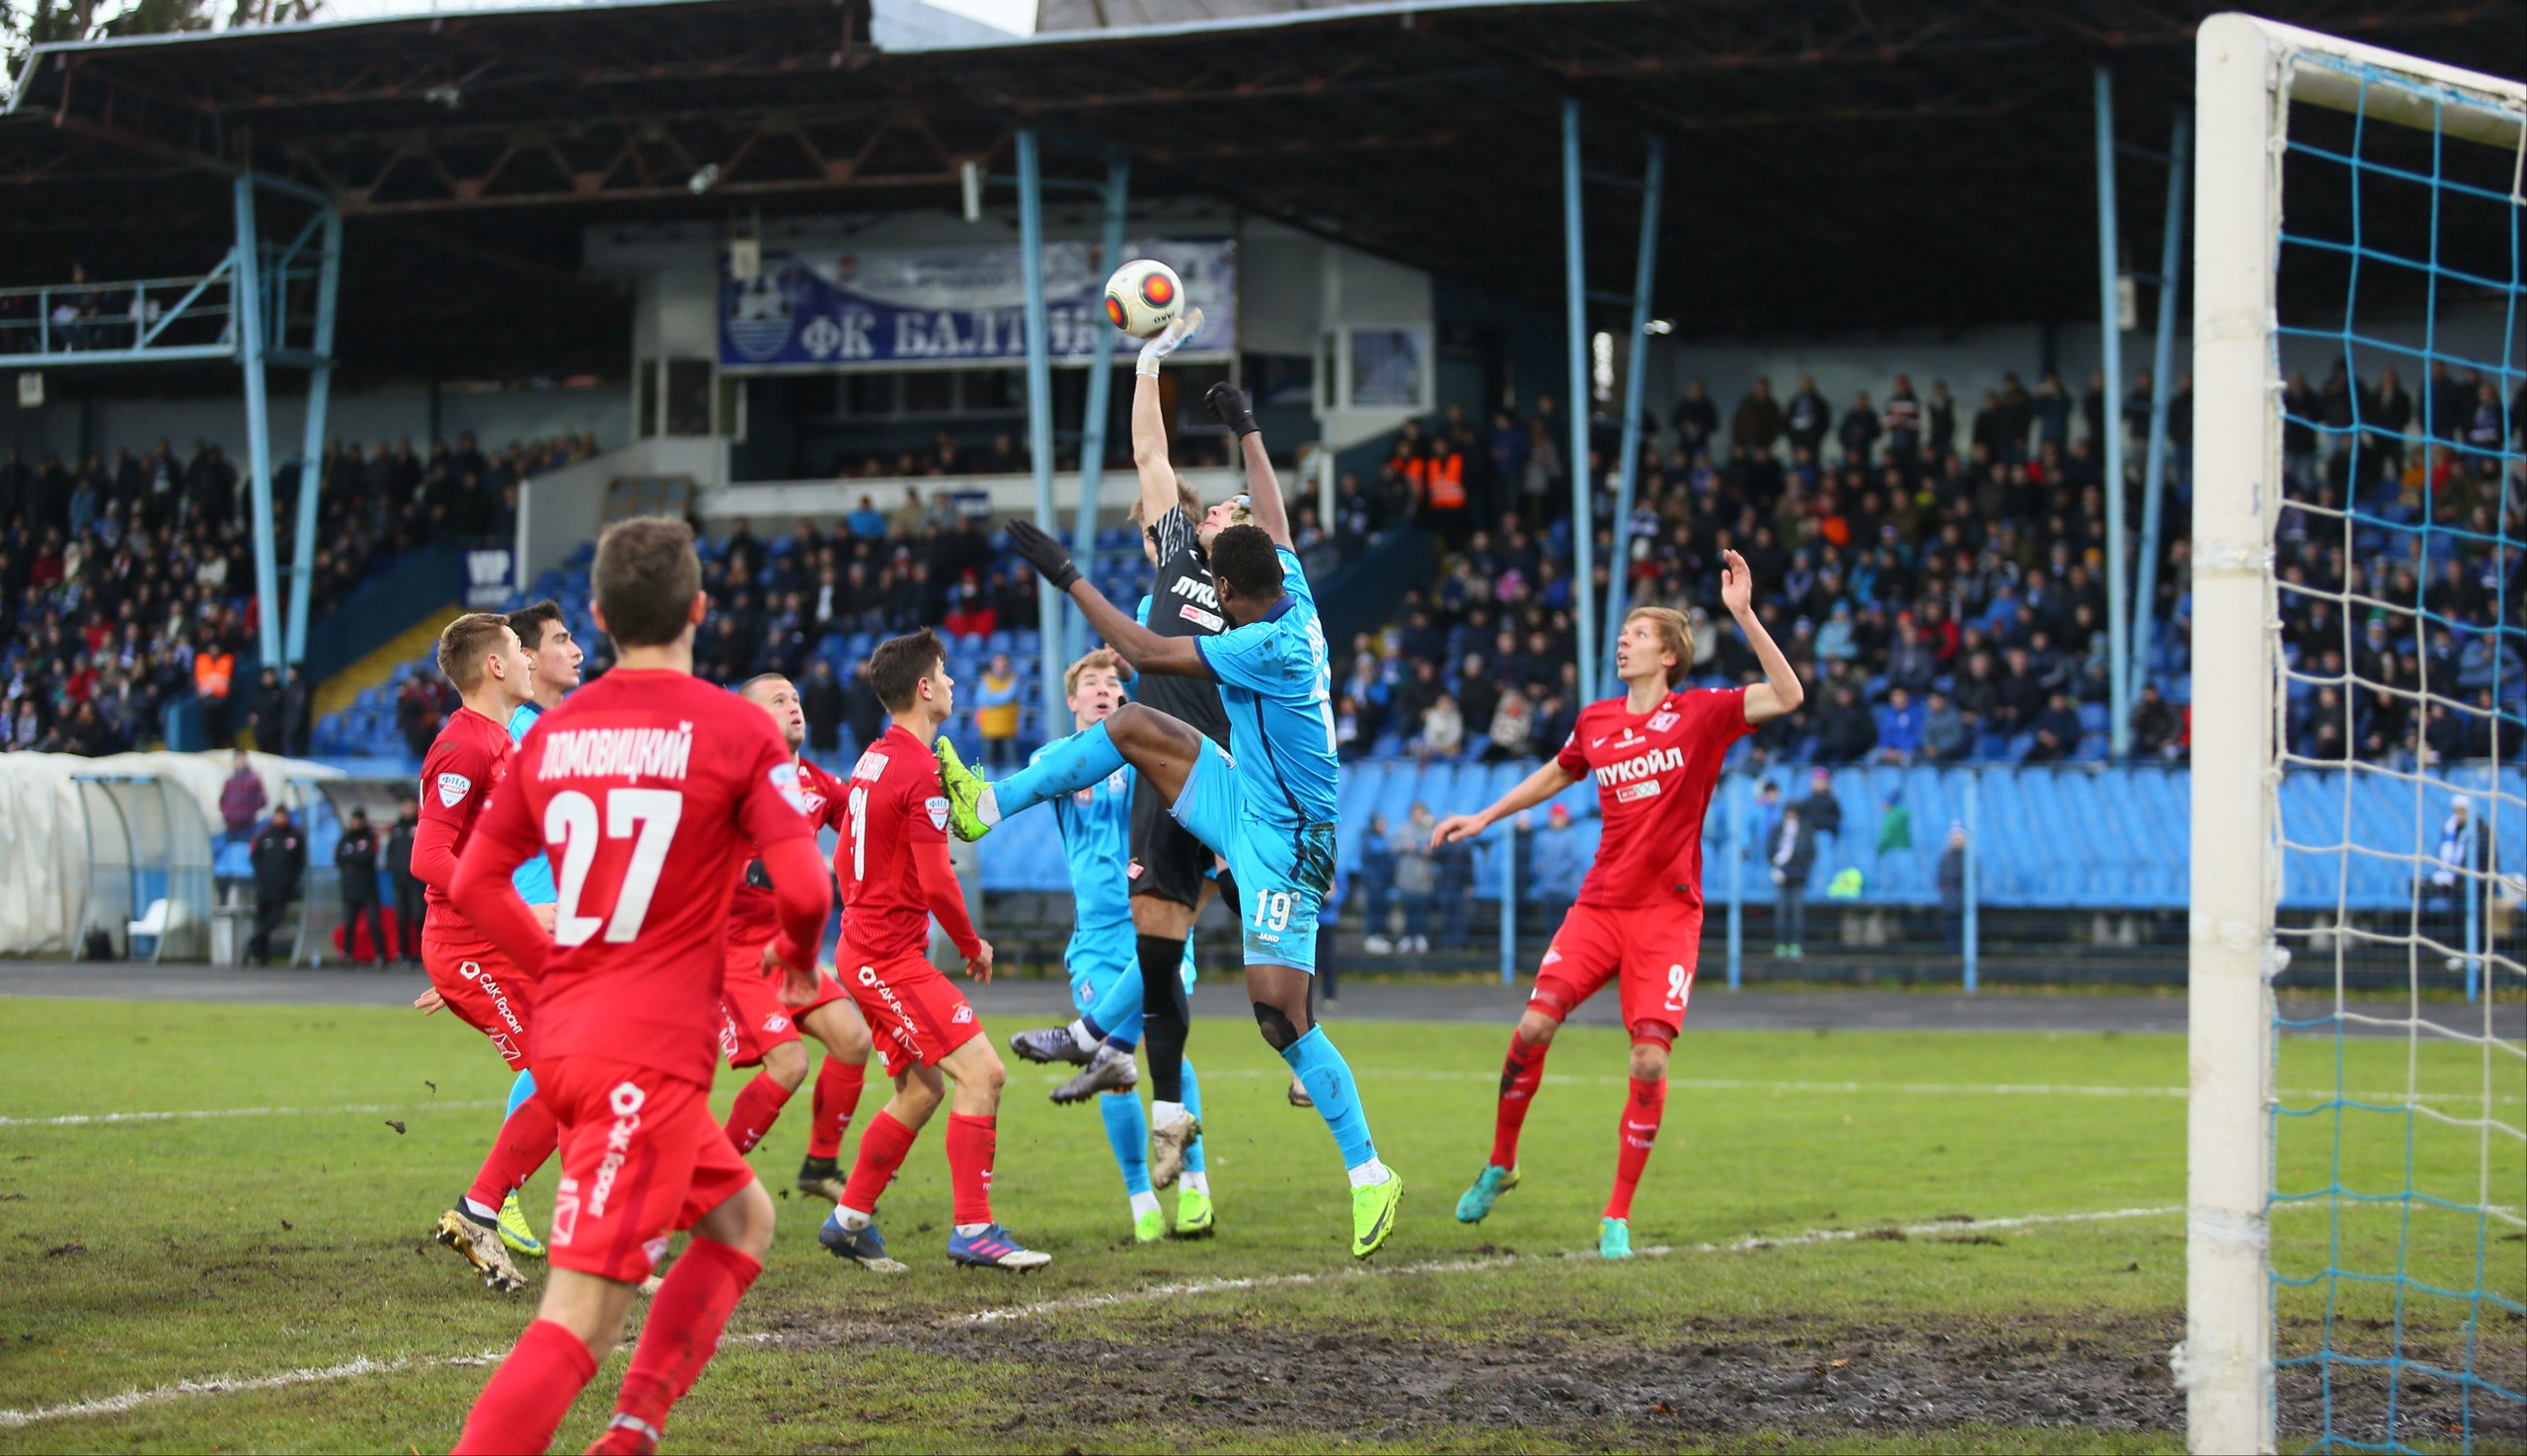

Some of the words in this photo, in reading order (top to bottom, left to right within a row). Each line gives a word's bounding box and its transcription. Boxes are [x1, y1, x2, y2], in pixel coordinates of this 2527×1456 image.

[801, 313, 876, 358] ФК
[892, 309, 1146, 356] БАЛТК
[1170, 575, 1221, 610] ЛУКО
[538, 721, 693, 784] ЛОМОВИЦКИЙ
[1595, 747, 1684, 787] ЛУКОЙЛ
[544, 789, 683, 947] 27
[1255, 888, 1291, 932] 19
[1258, 932, 1279, 943] JAKO
[495, 996, 524, 1035] Гарант
